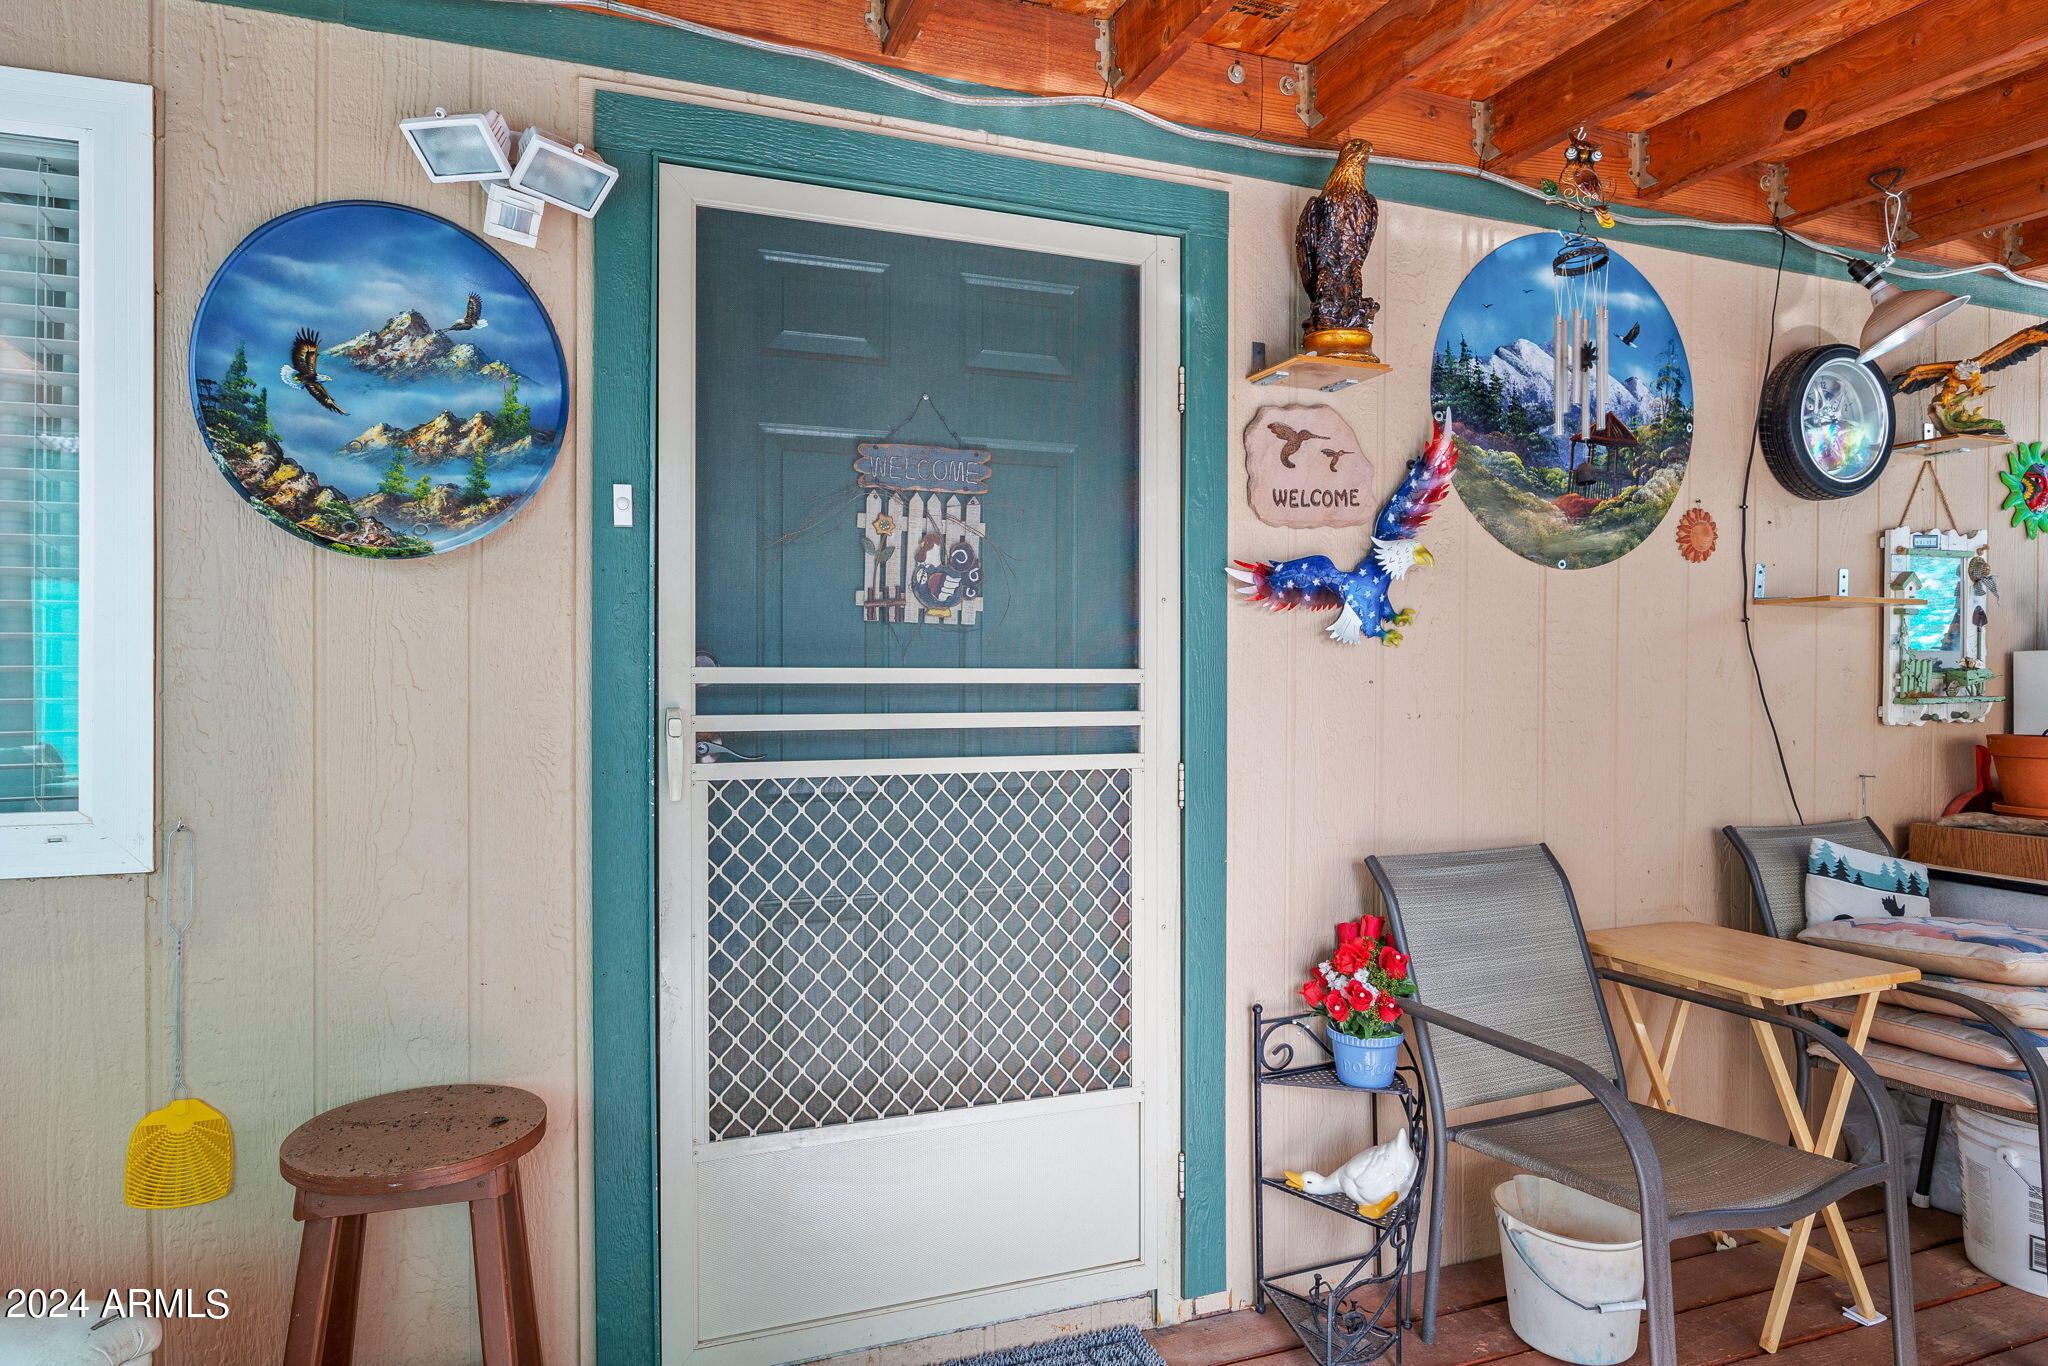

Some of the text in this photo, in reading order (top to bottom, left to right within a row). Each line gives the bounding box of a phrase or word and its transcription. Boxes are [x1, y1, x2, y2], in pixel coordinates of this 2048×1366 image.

[870, 456, 979, 484] WELCOME
[1272, 488, 1360, 508] WELCOME
[1344, 1060, 1396, 1076] POPCO
